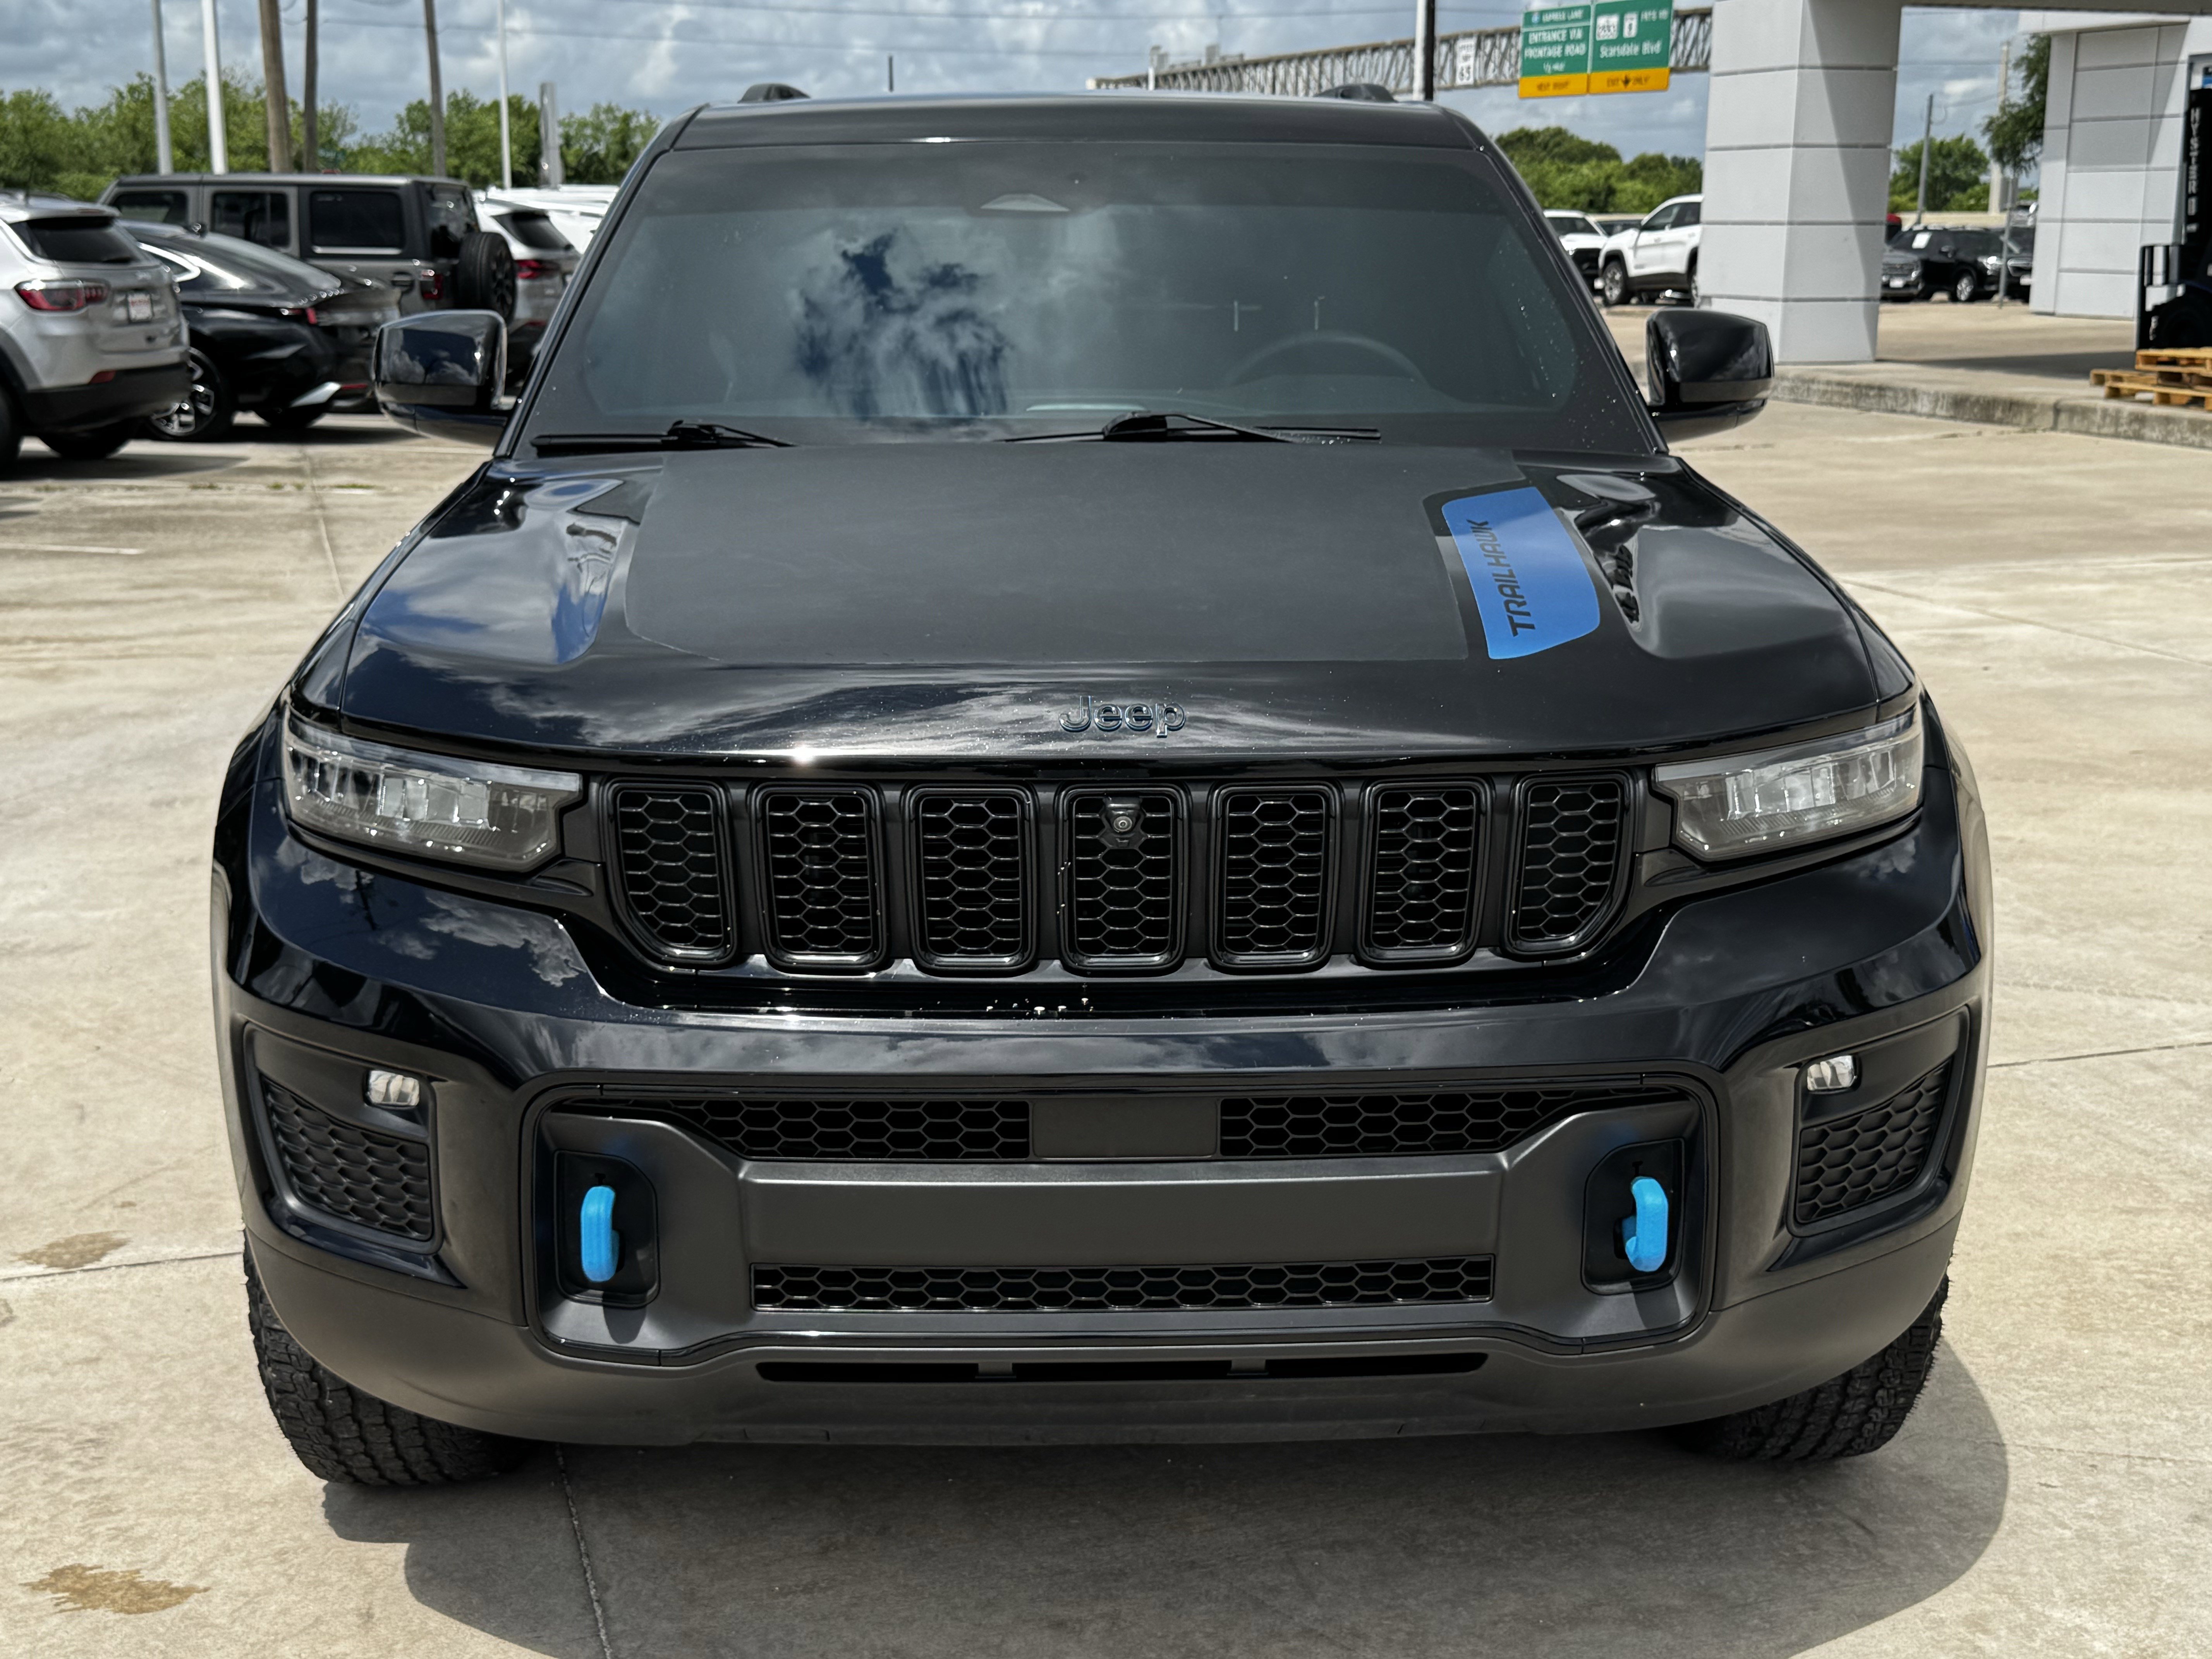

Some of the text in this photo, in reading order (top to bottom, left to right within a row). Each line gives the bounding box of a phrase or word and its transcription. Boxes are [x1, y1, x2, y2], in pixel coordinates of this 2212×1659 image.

[1528, 29, 1567, 45] ENTRANCE
[1569, 27, 1583, 40] VIA
[1600, 40, 1662, 58] Scarsdale Blvd
[1524, 43, 1587, 60] FRONTAGE ROAD
[2188, 106, 2201, 194] HYSTER
[1466, 519, 1536, 637] TRAILHAWK
[1059, 696, 1186, 738] Jeep
